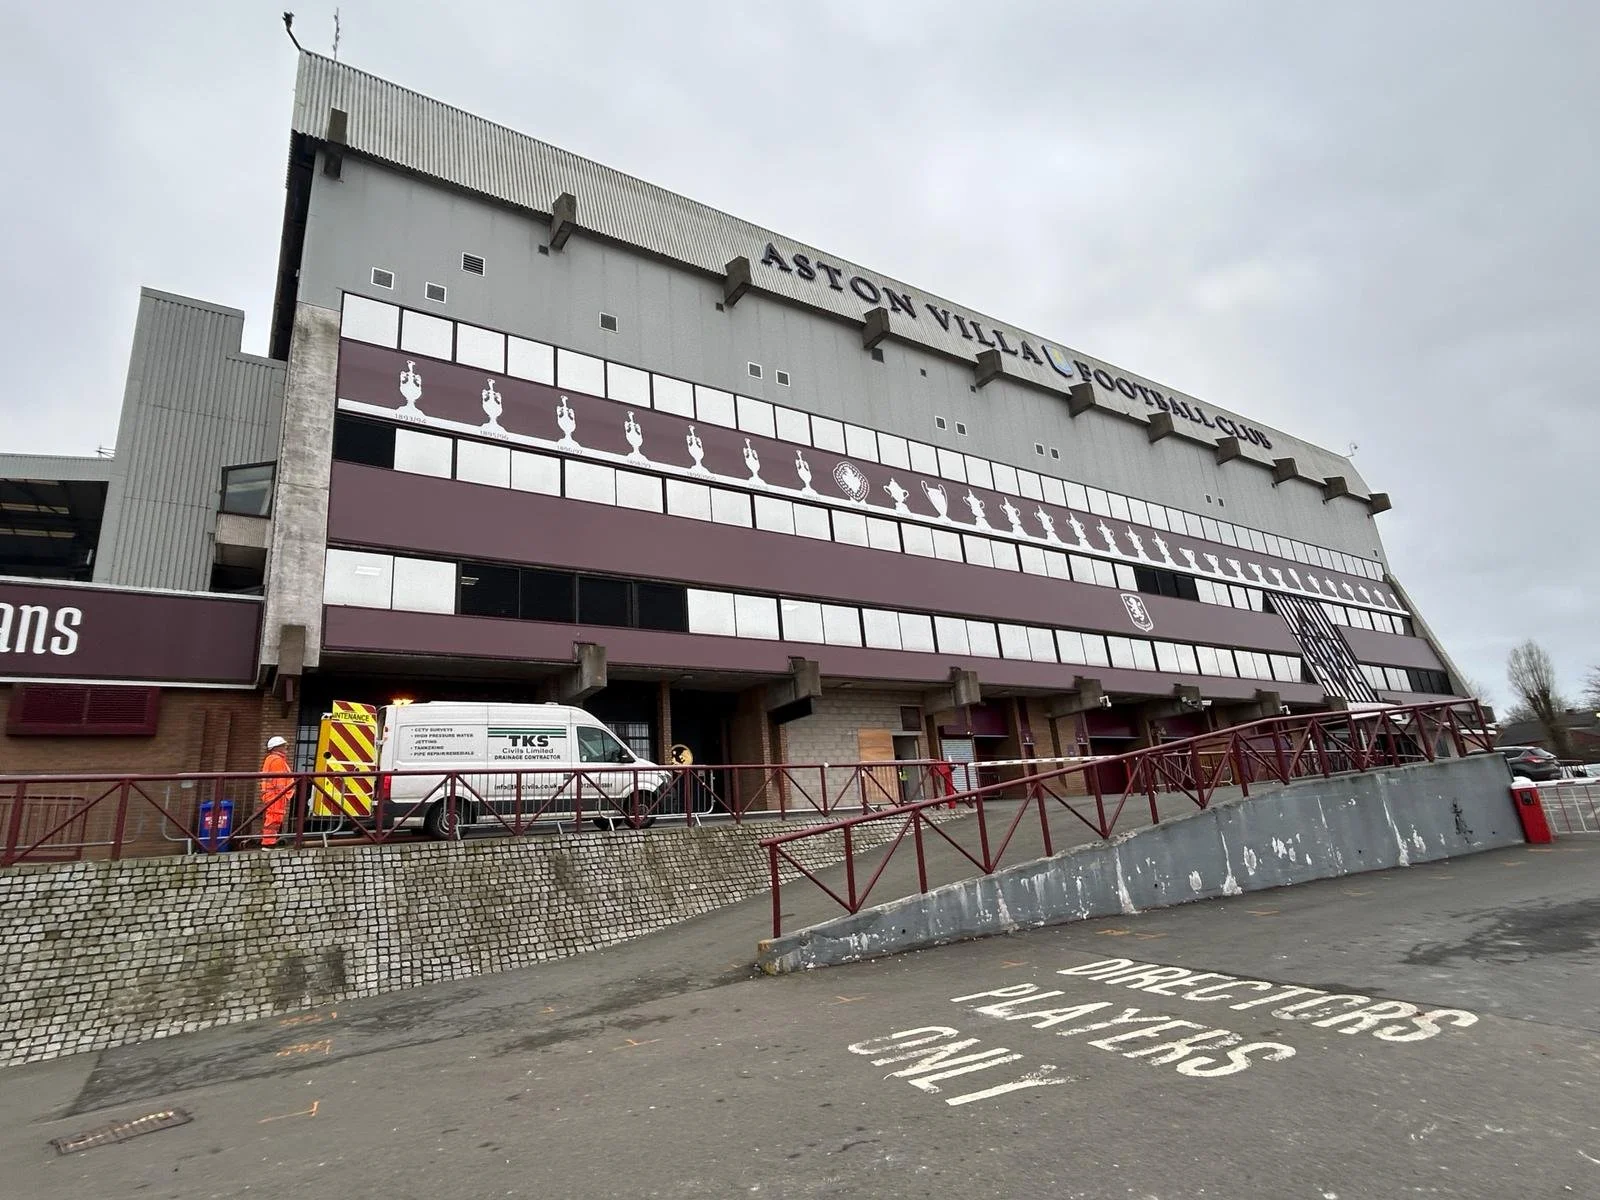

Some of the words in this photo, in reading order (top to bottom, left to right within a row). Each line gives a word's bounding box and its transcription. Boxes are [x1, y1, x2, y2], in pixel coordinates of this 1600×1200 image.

[761, 242, 917, 318] ASTON
[926, 303, 1043, 365] VILLA
[1073, 359, 1215, 429] FOOTBALL
[1215, 415, 1273, 450] CLUB
[508, 735, 549, 747] TKS
[950, 983, 1297, 1078] PLAYERS
[1056, 958, 1480, 1043] DIRECTORS
[848, 1025, 1078, 1106] ONLY
